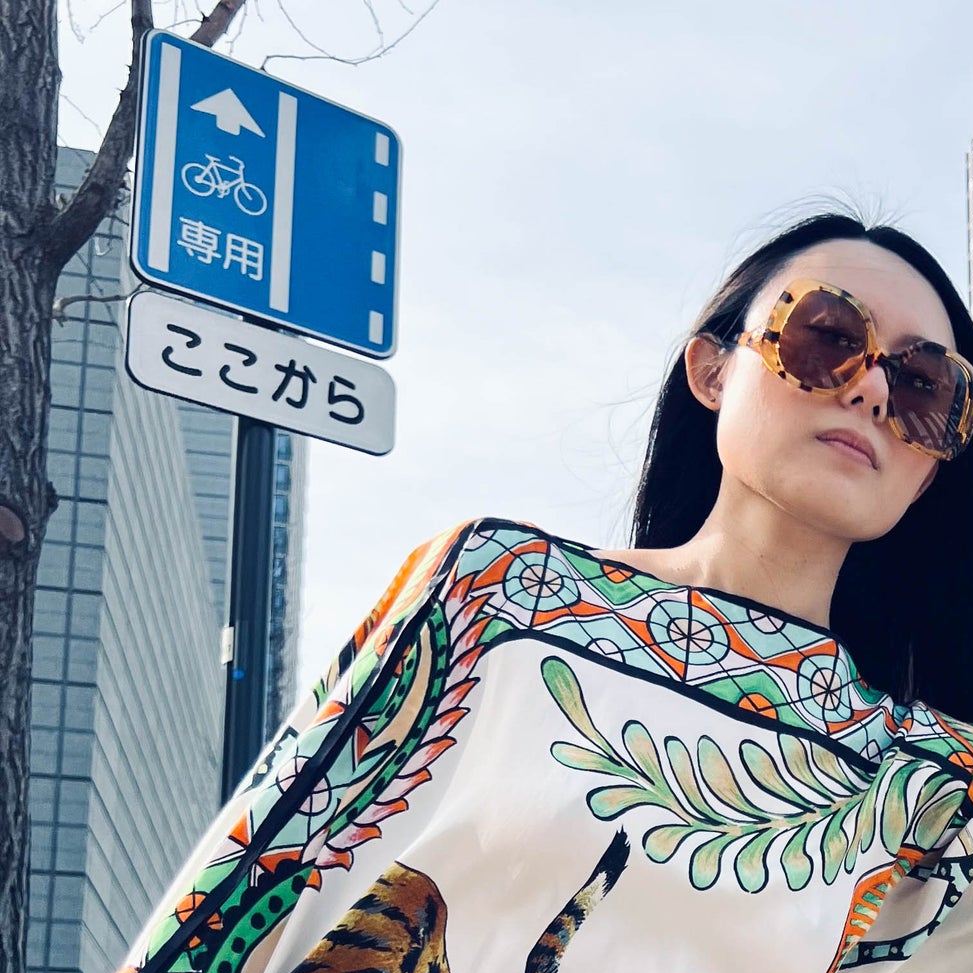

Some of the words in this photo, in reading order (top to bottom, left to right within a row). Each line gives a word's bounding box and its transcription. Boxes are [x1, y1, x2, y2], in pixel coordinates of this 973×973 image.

[177, 216, 264, 281] 専用
[162, 324, 365, 425] ここから
